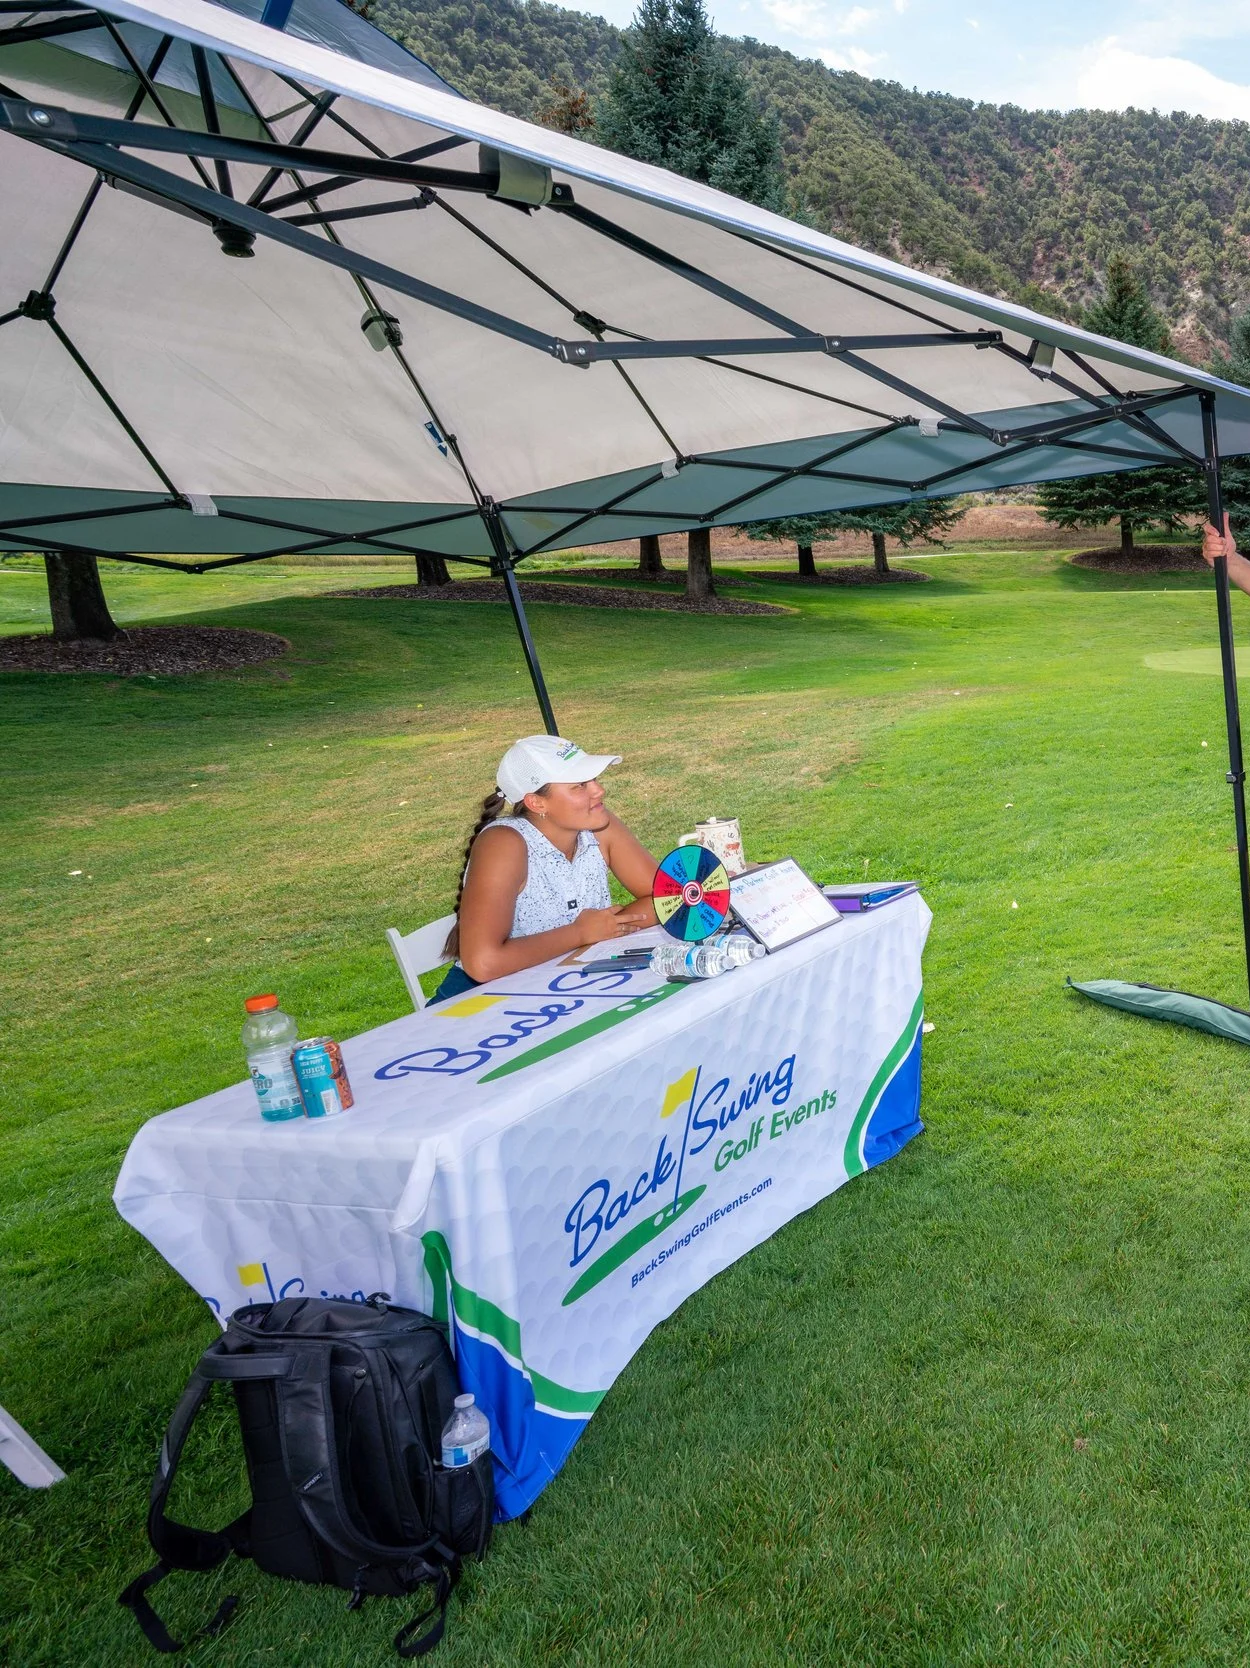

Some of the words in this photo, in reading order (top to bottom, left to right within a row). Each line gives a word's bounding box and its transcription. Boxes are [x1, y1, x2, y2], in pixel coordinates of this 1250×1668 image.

[374, 1000, 584, 1080] Back
[252, 1078, 273, 1089] ERO
[564, 1134, 676, 1267] Back
[690, 1054, 796, 1155] Swing
[714, 1116, 764, 1172] Golf
[770, 1089, 837, 1140] Events
[631, 1177, 772, 1288] BackSwingGolfEvents.com
